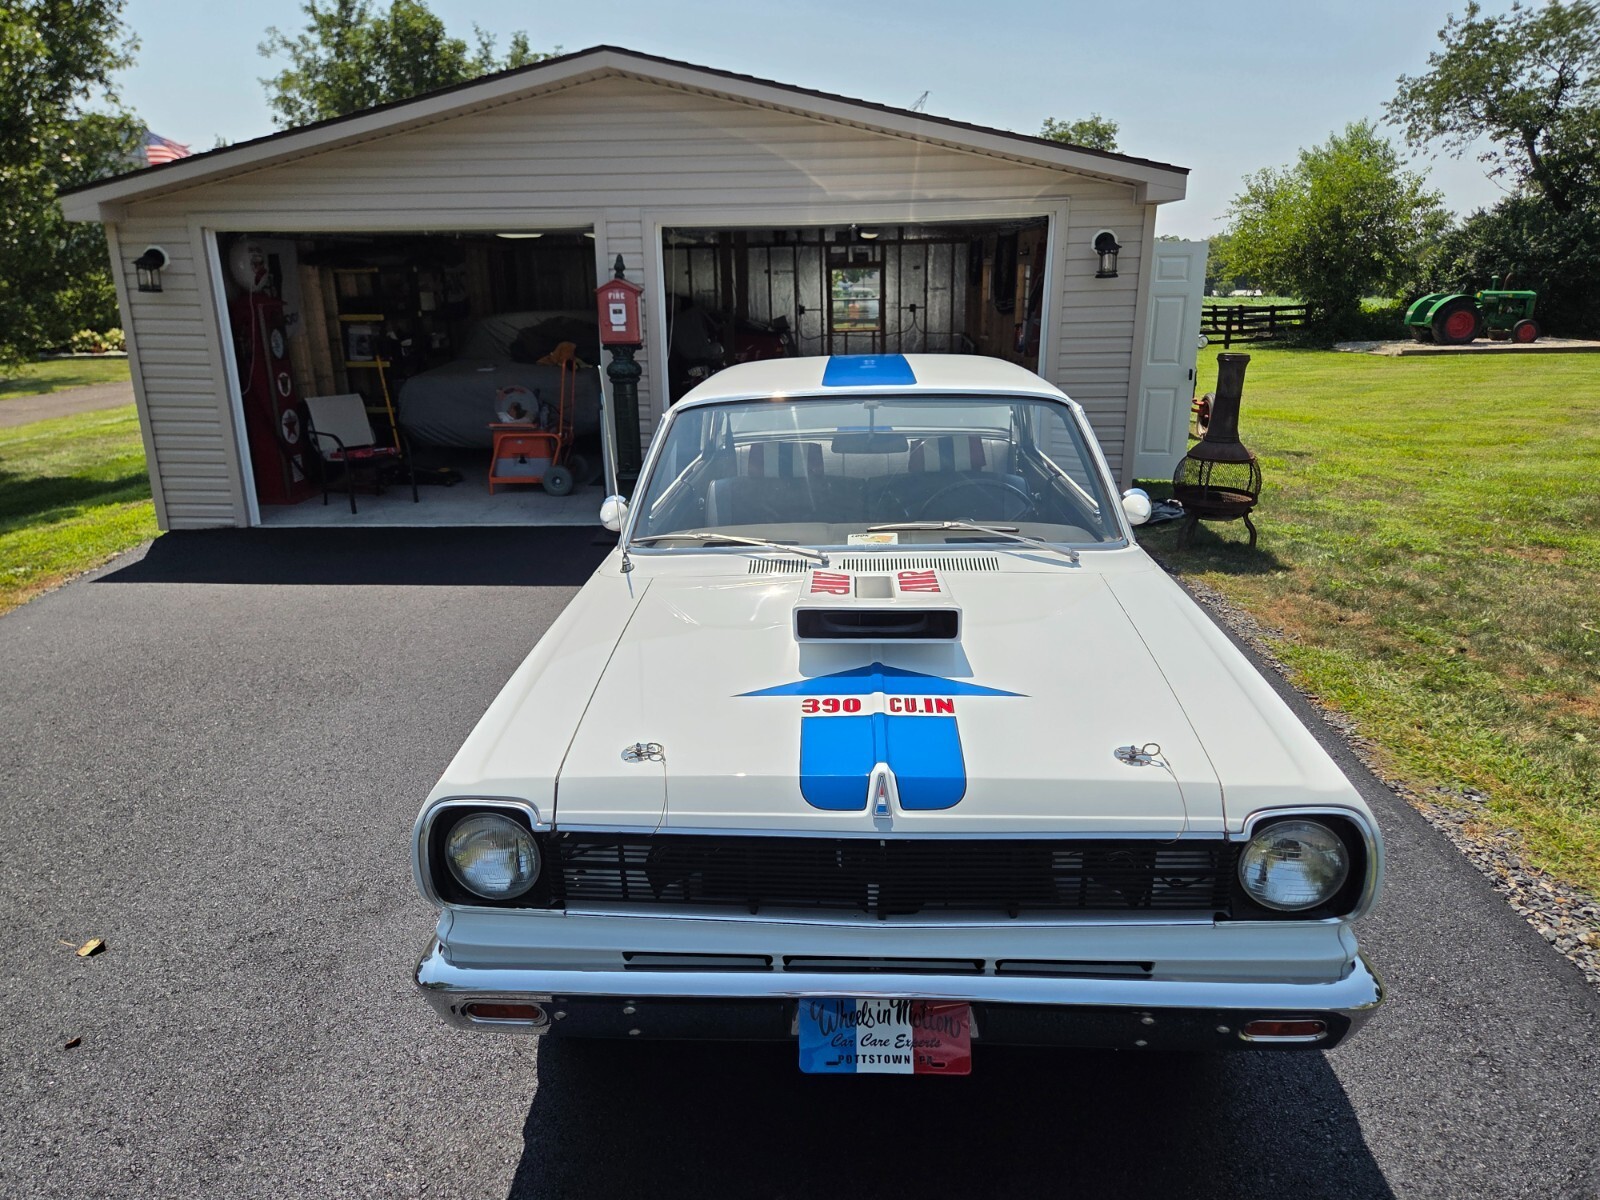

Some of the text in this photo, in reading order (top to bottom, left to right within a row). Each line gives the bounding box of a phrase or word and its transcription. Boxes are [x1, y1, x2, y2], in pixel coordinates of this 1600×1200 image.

[608, 292, 625, 300] FIRE
[811, 571, 850, 595] AIR
[898, 570, 941, 592] AIR
[802, 697, 955, 713] 390 CU.IN
[810, 999, 961, 1038] Wheels in Motion
[831, 1032, 942, 1050] Car Care Experts
[838, 1054, 911, 1064] POTTSTOWN
